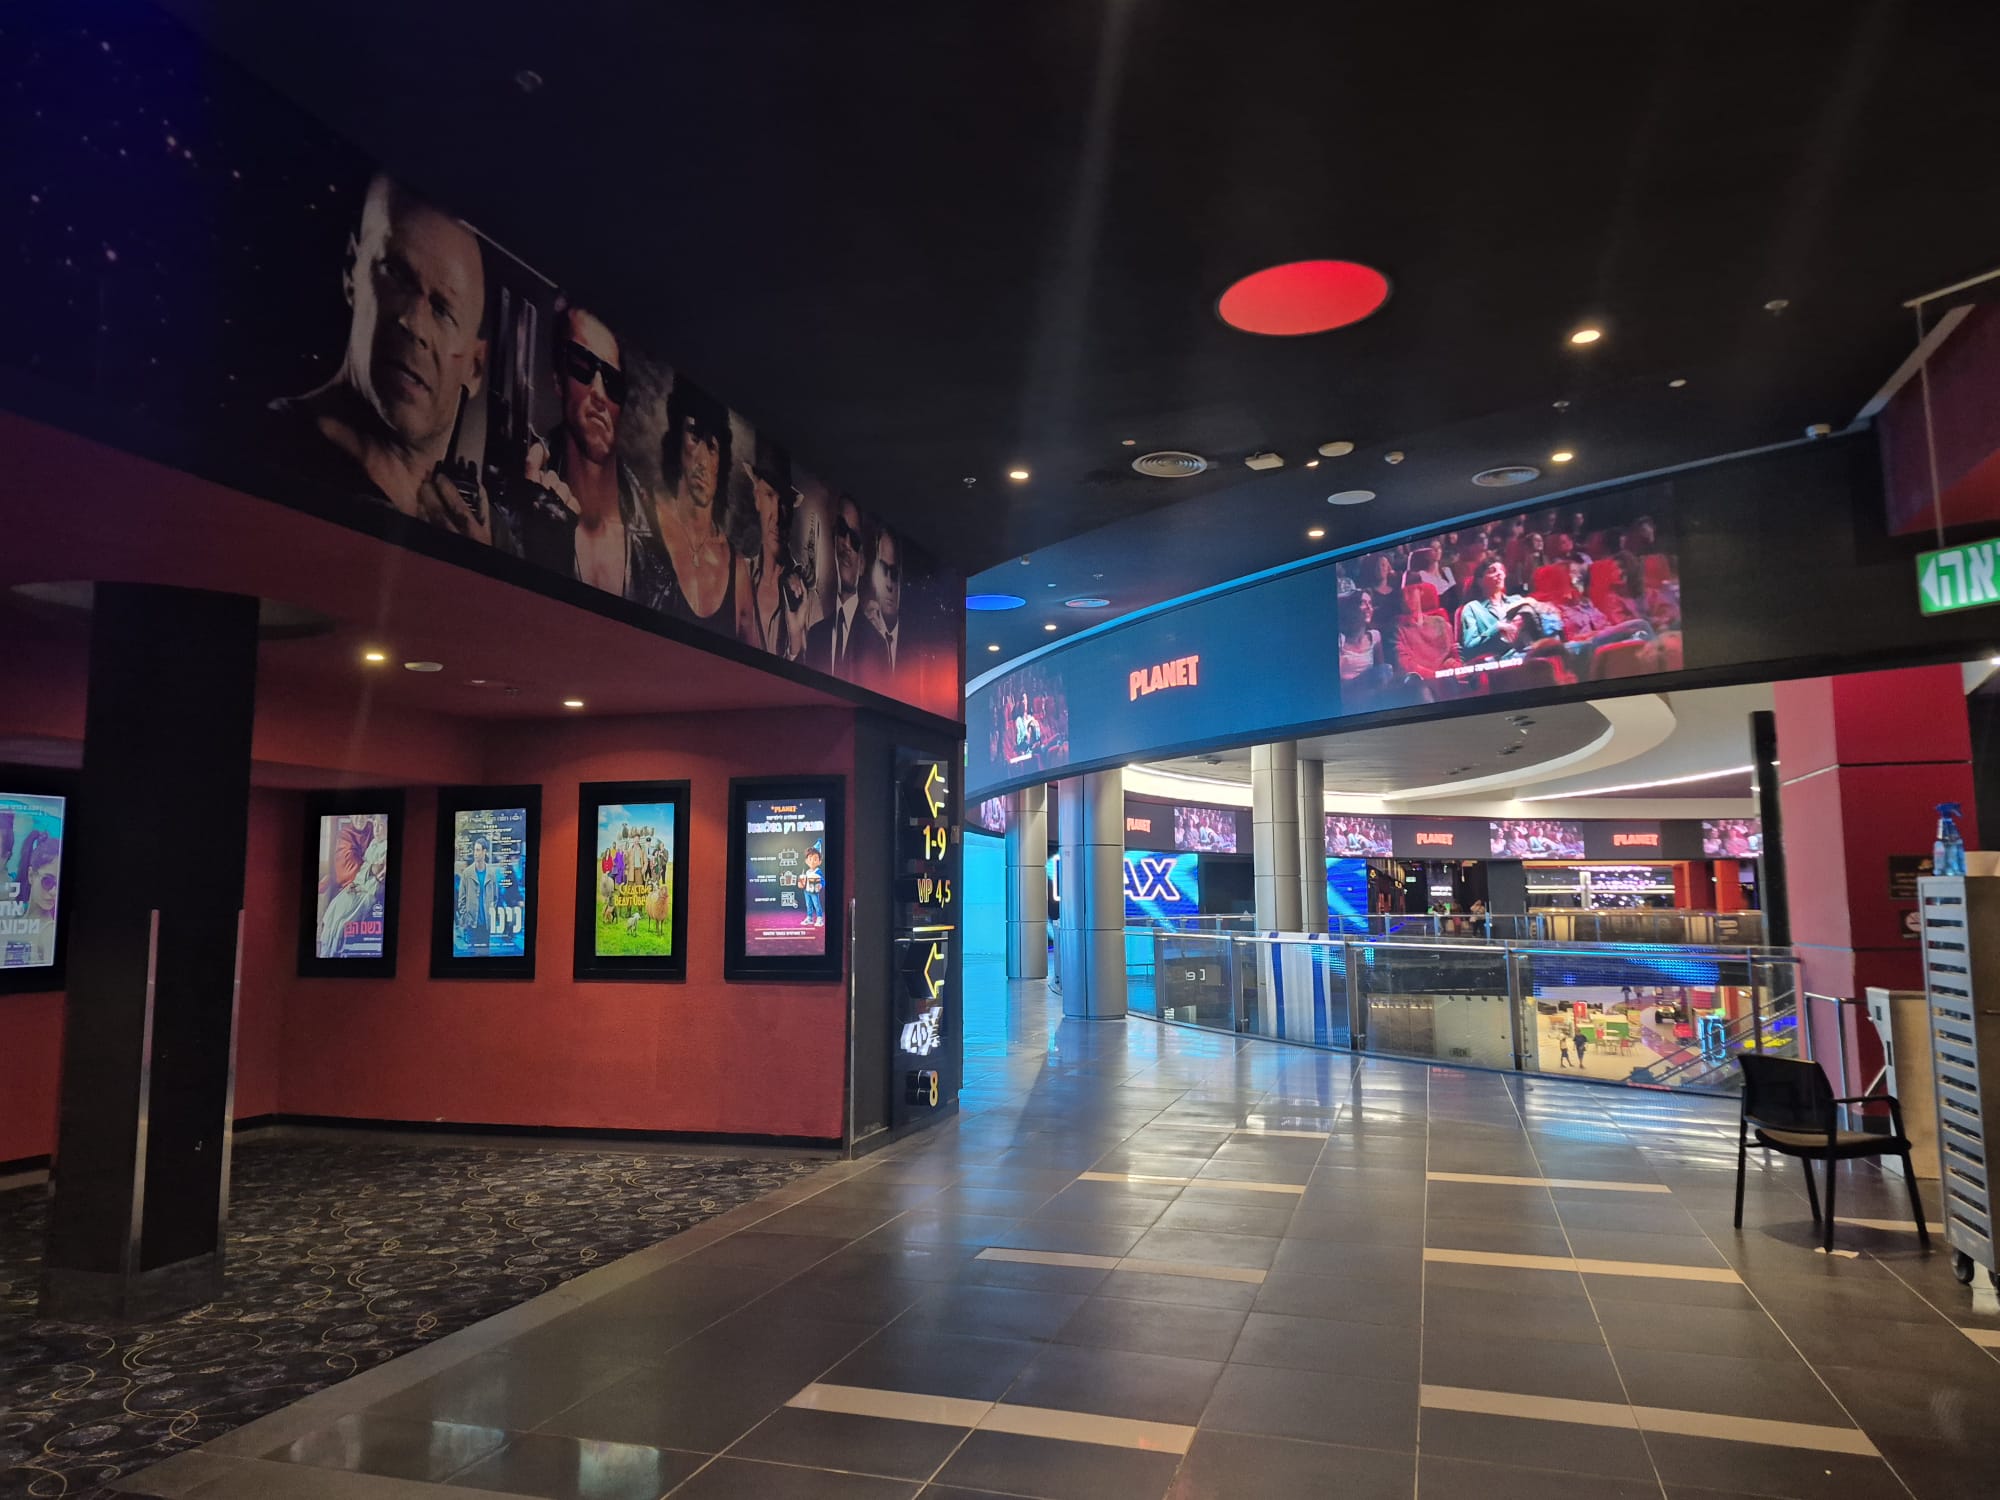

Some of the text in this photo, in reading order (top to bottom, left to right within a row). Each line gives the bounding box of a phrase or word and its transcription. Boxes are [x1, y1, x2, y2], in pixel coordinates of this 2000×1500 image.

[1939, 541, 2000, 607] אה
[1129, 655, 1200, 702] PLANET
[1126, 817, 1151, 833] PLANET
[1416, 832, 1453, 845] PLANET
[1613, 833, 1658, 846] PLANET
[923, 825, 947, 861] 1-9
[917, 875, 951, 908] VIP 4,5
[488, 906, 522, 934] נינו
[929, 1070, 939, 1107] 8
